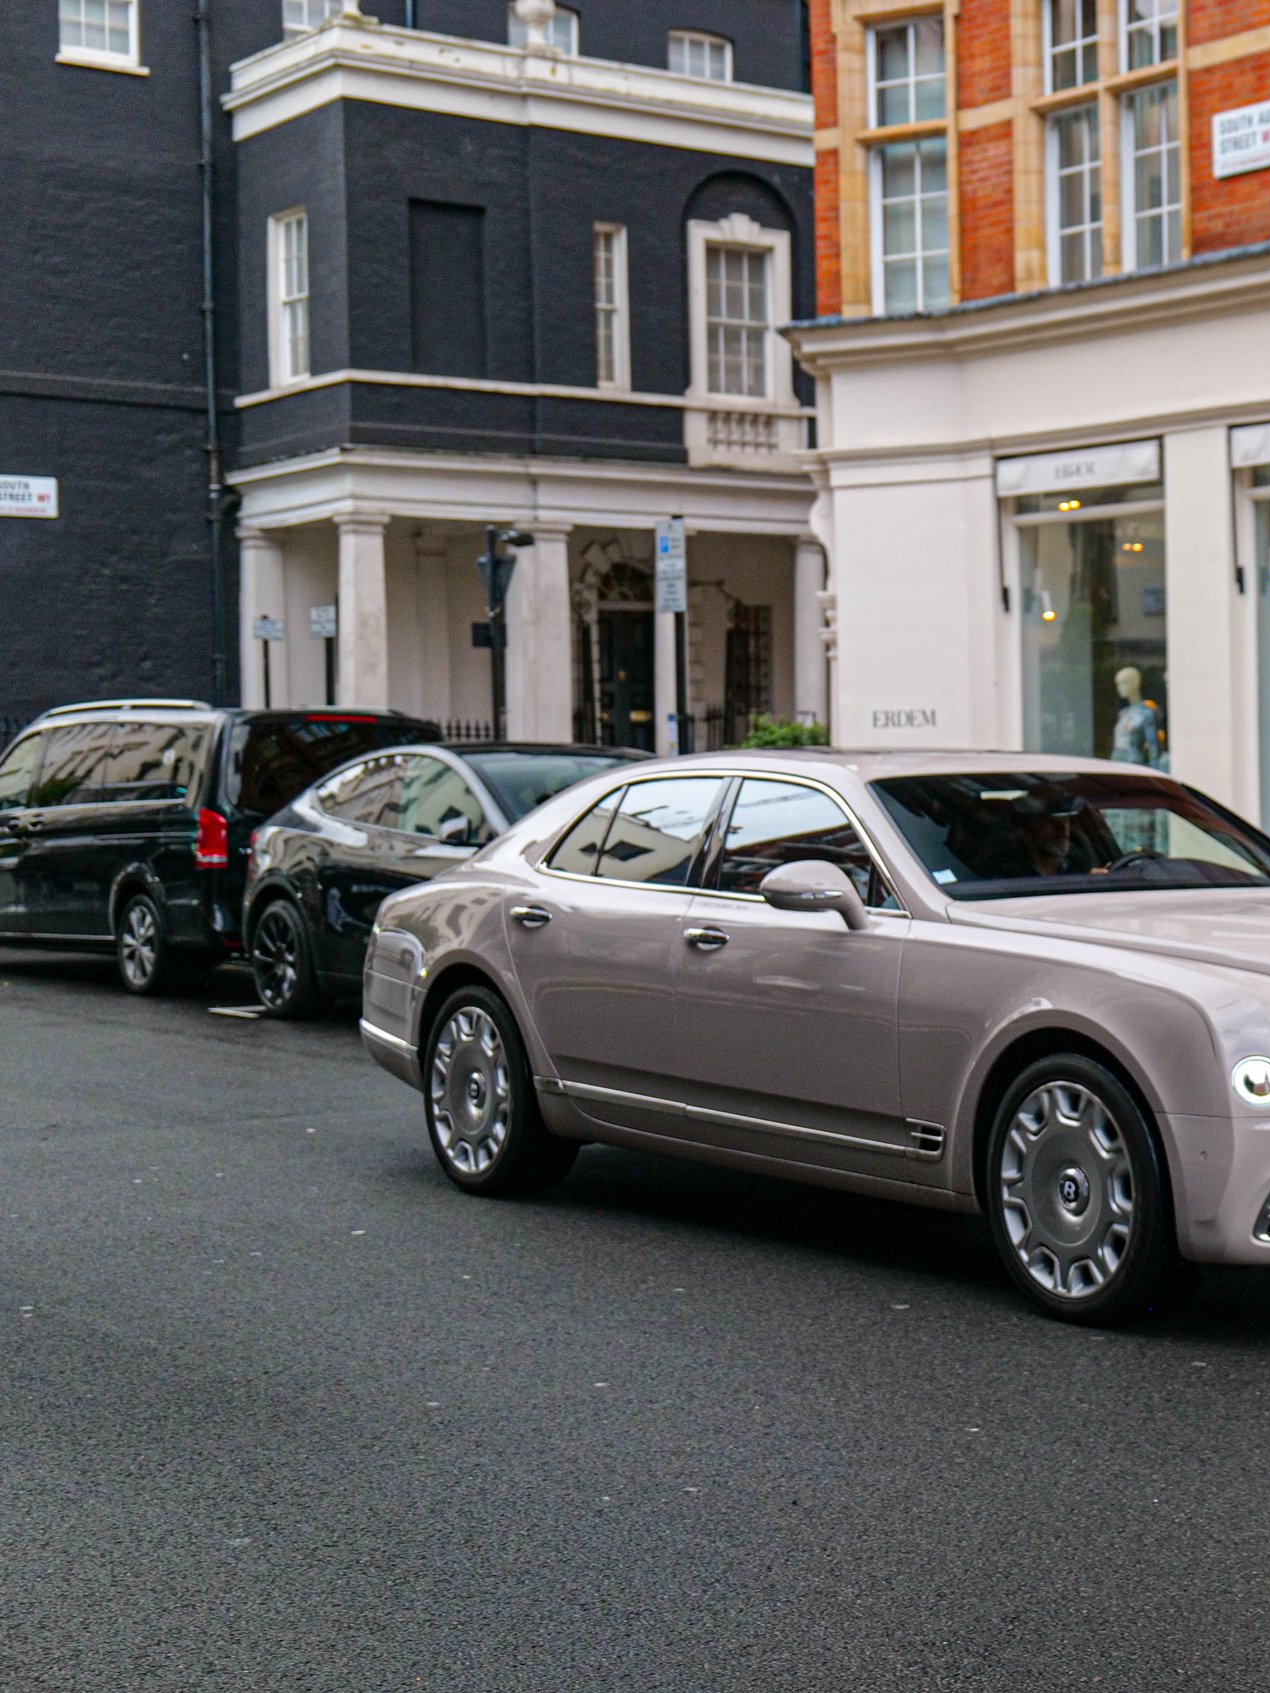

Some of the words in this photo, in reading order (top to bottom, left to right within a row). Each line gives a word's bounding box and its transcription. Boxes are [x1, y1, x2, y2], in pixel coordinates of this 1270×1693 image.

[1220, 113, 1253, 135] SOUTH
[1220, 131, 1256, 155] STREET
[872, 708, 937, 729] ERDEM
